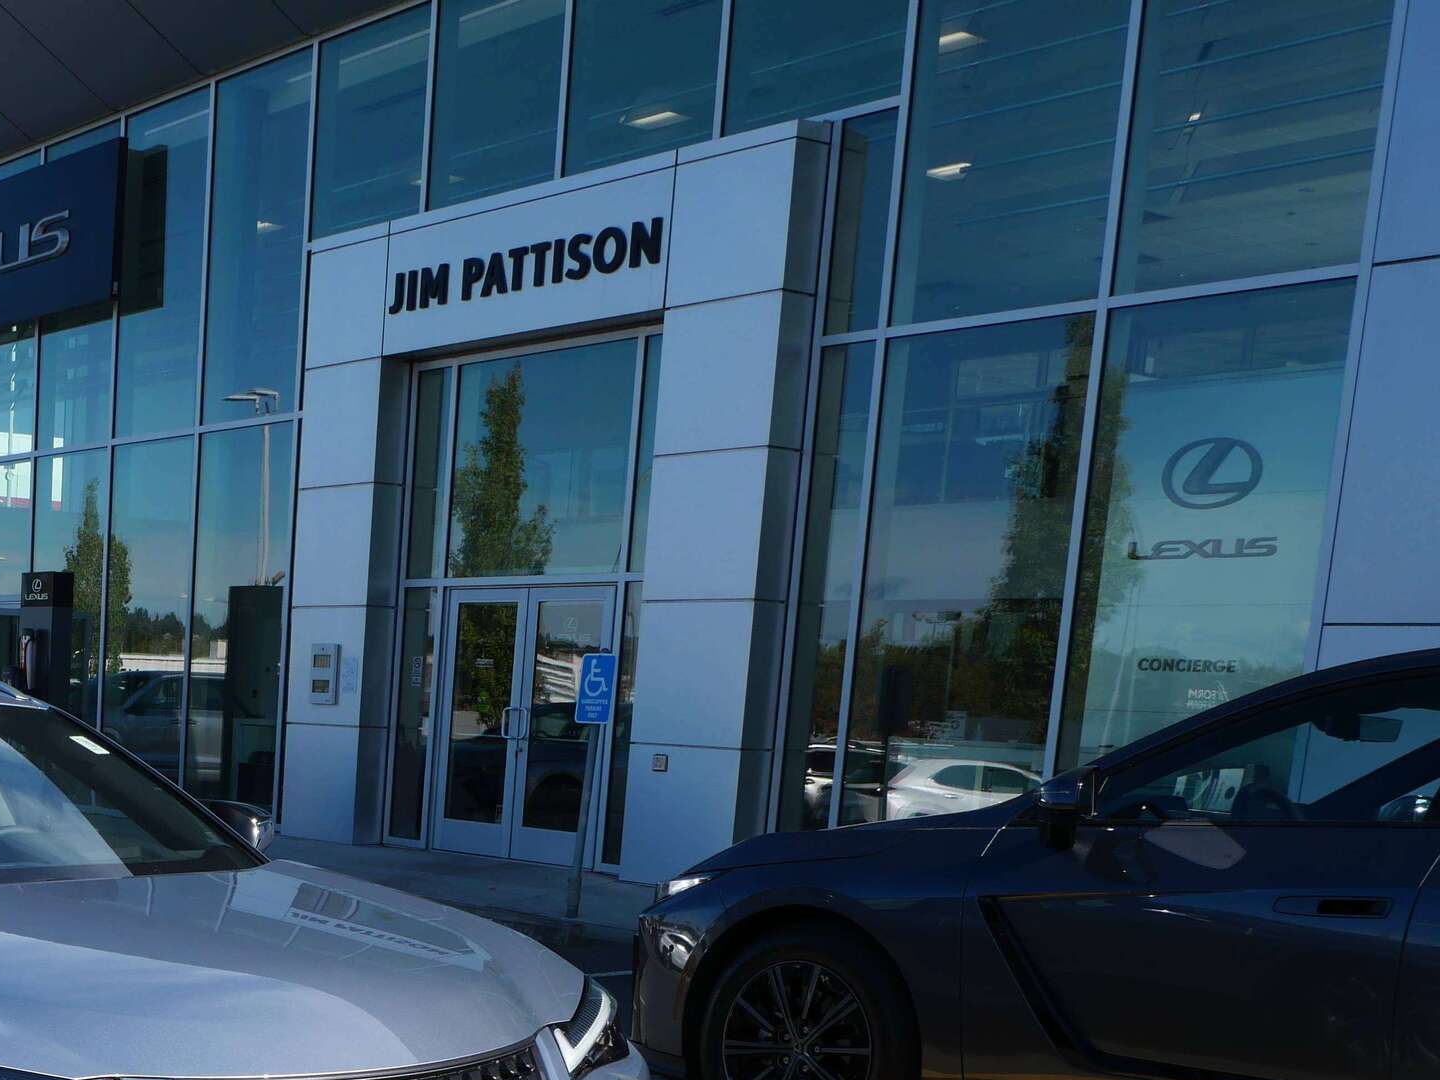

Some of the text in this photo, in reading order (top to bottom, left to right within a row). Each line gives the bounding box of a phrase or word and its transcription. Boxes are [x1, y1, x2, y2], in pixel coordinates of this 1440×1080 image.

[389, 216, 664, 315] JIM PATTISON
[1127, 536, 1278, 561] LEXUS
[1137, 657, 1238, 673] CONCIERGE
